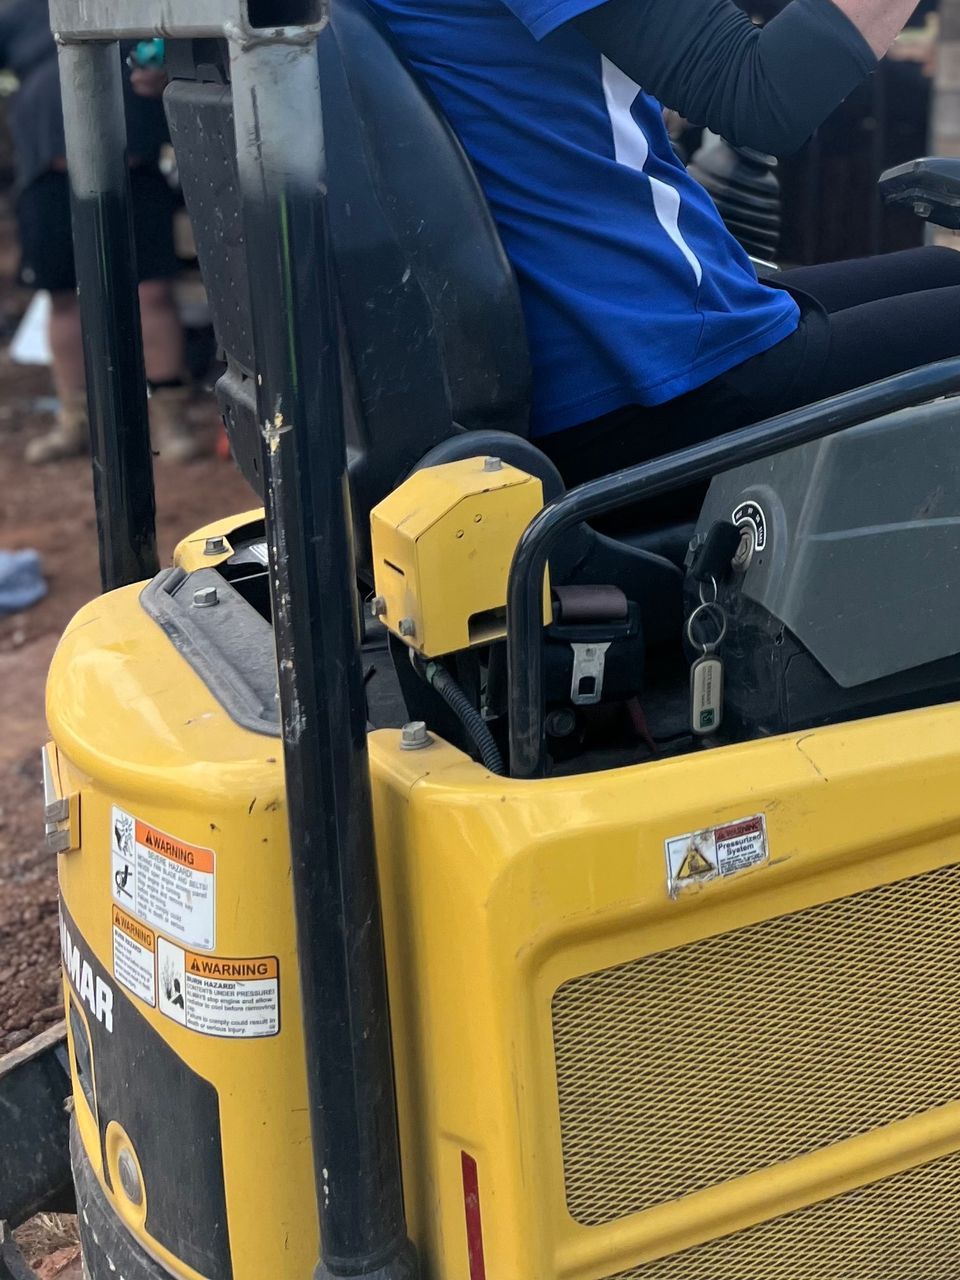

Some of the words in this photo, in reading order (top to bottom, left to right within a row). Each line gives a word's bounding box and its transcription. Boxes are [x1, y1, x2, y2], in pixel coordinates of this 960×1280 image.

[718, 833, 761, 850] Pressurized
[727, 843, 754, 856] System
[154, 837, 194, 865] WARNING
[122, 916, 152, 948] WARNING
[202, 960, 268, 977] WARNING
[204, 980, 236, 990] HAZARD!
[237, 988, 274, 998] PRESSURE!
